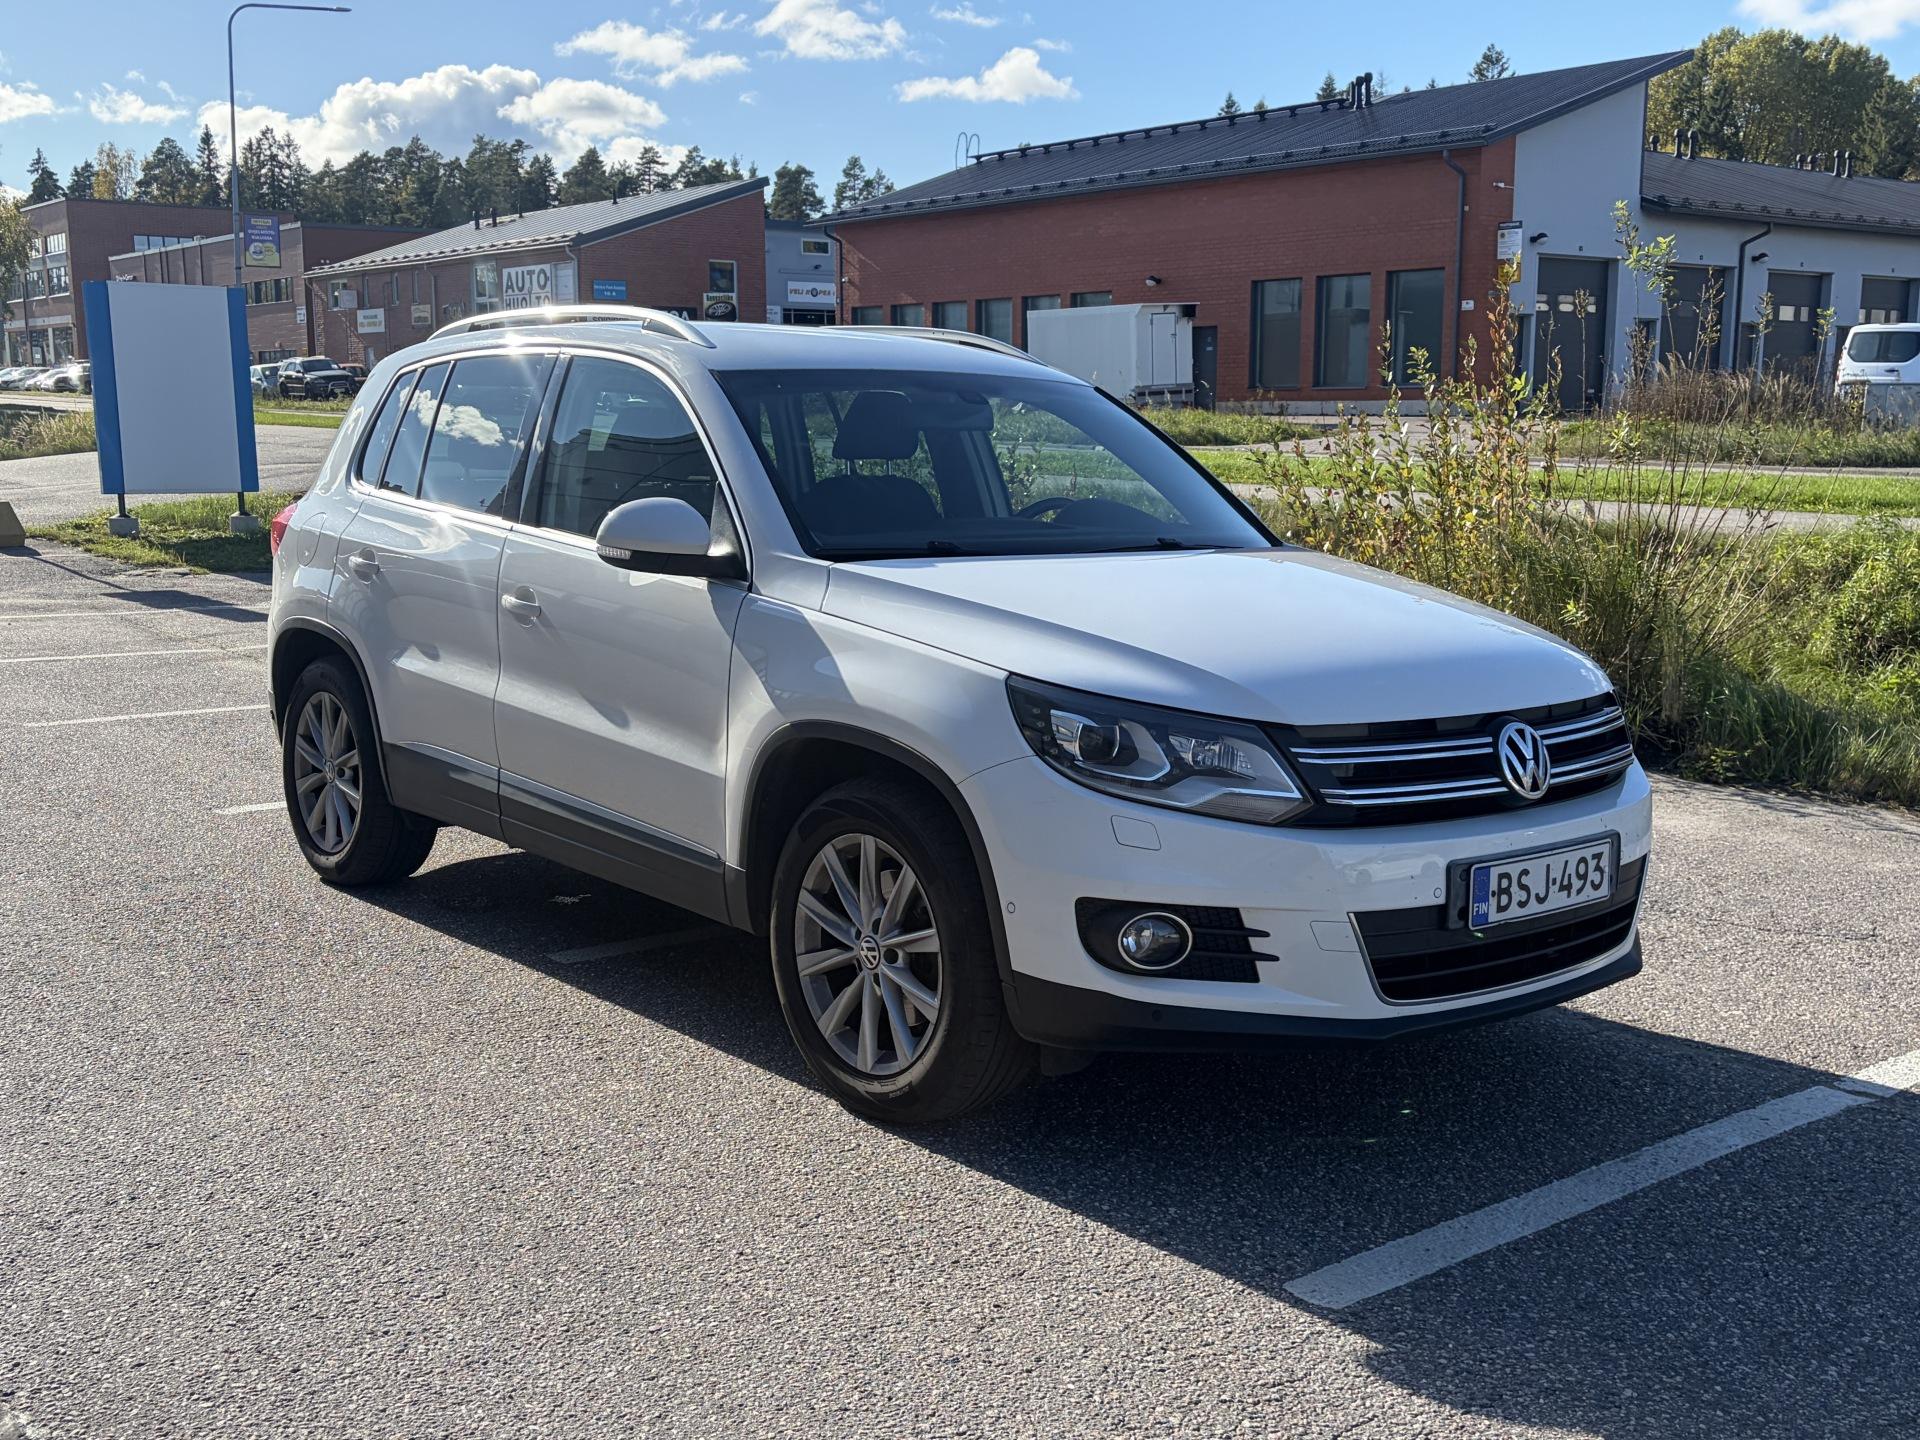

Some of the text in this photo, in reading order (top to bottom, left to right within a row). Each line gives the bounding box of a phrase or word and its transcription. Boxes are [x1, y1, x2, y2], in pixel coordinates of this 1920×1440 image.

[1499, 722, 1551, 799] VW
[1473, 901, 1489, 916] FIN
[1496, 851, 1605, 914] BSJ-493
